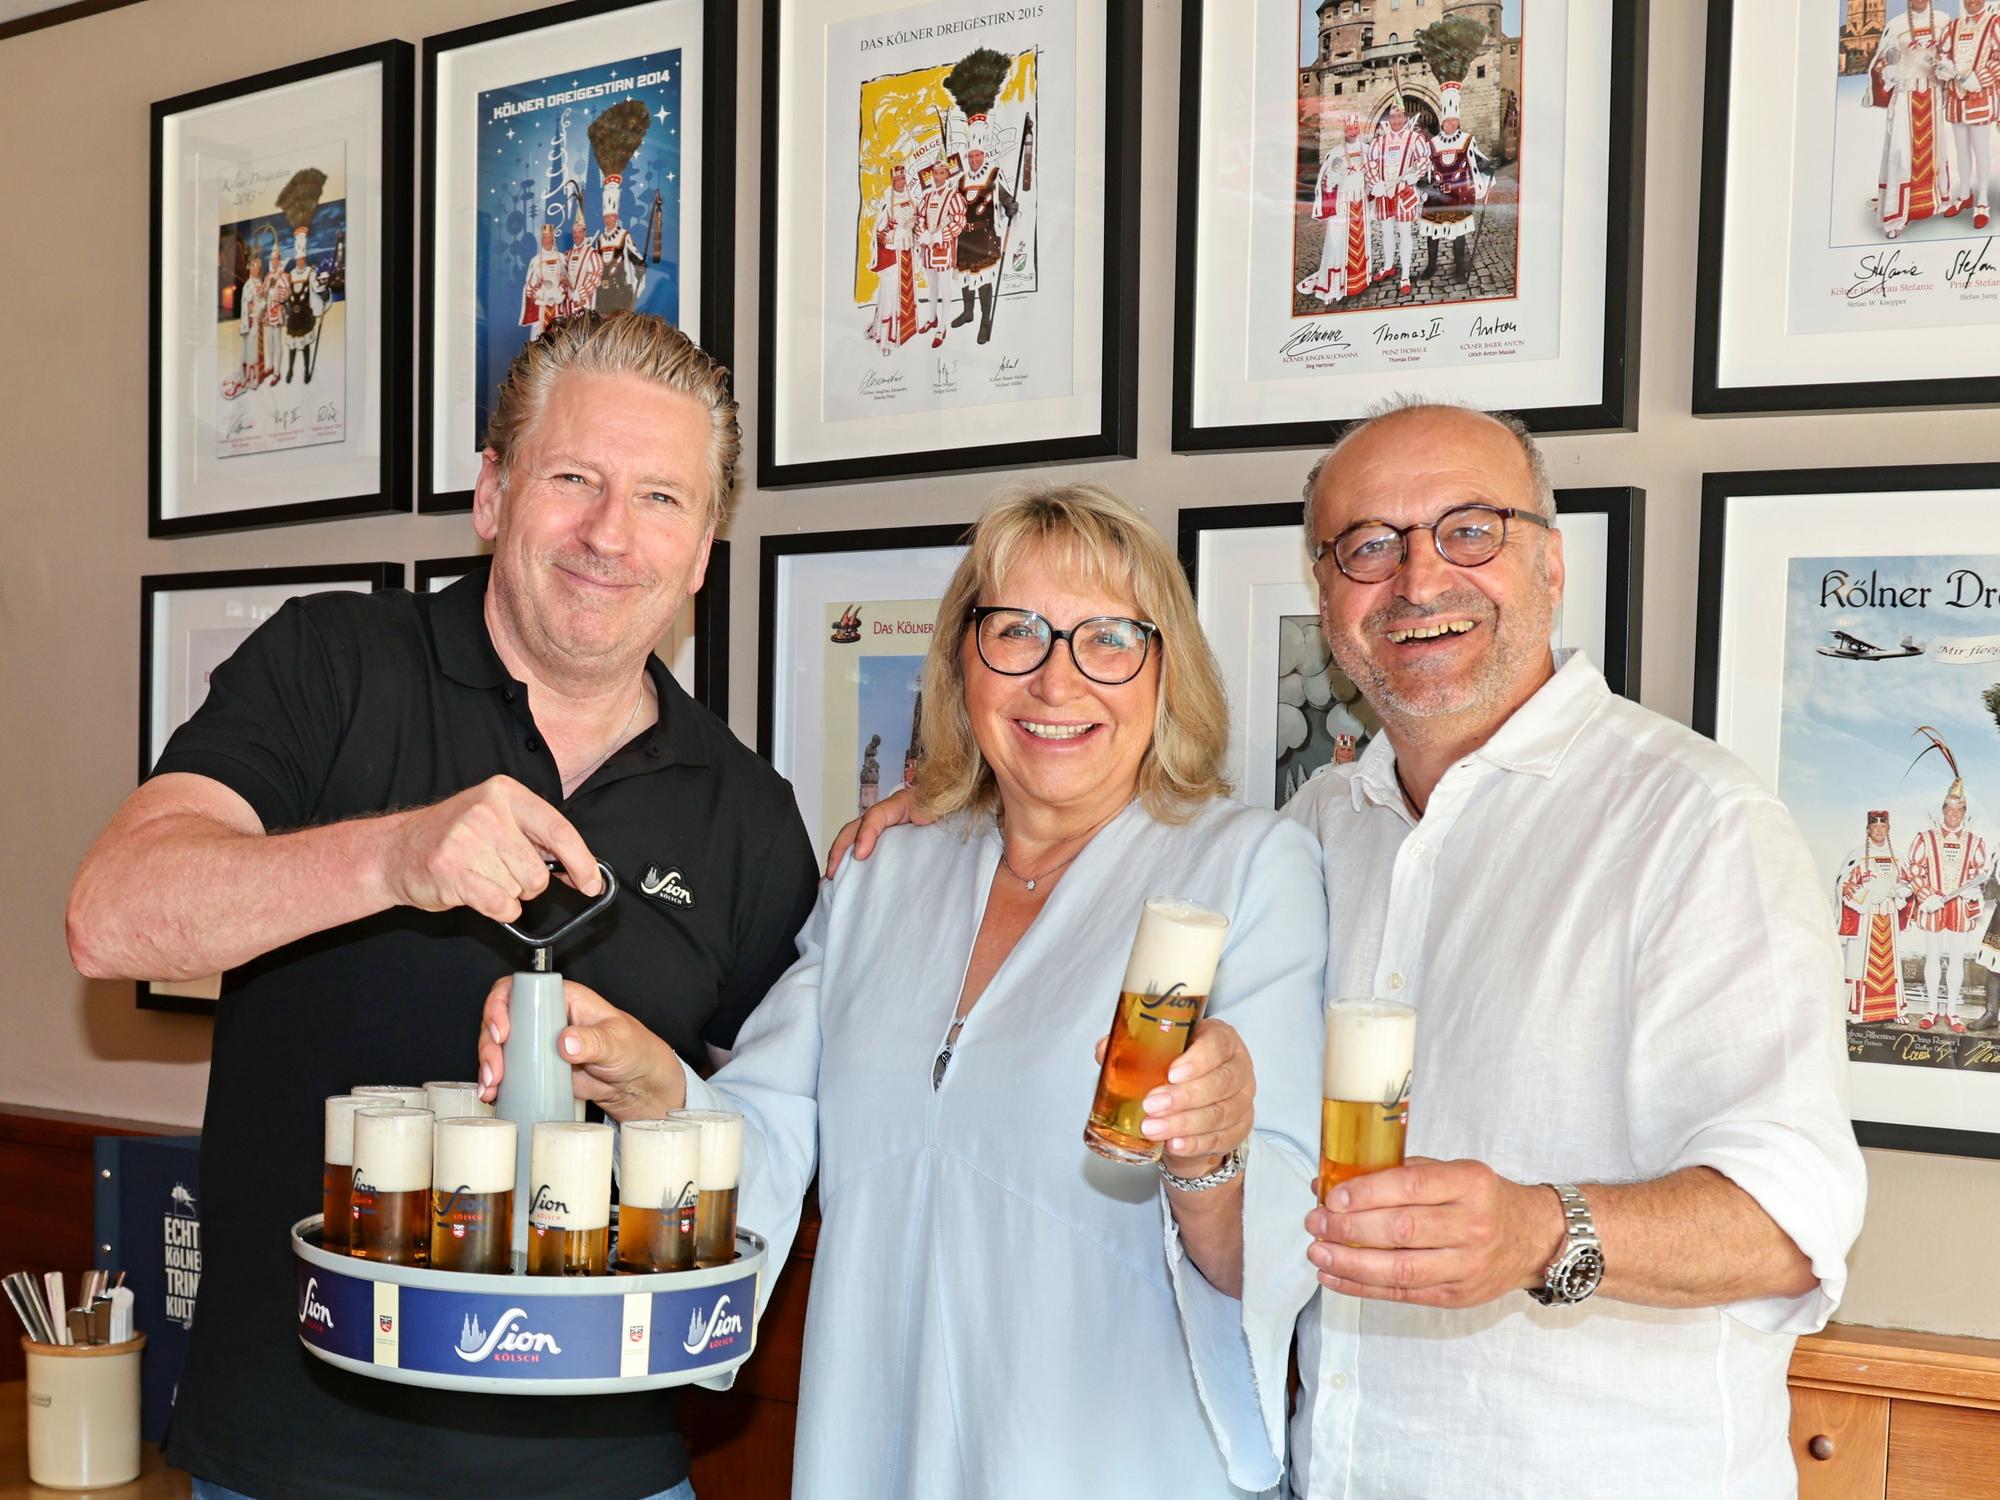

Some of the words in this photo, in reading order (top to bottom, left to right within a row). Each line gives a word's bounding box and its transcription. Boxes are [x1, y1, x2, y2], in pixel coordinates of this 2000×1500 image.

[860, 36, 883, 52] DAS
[886, 27, 934, 47] KÖLNER
[936, 11, 1015, 36] DREIGESTIRN
[1018, 5, 1044, 20] 2015
[493, 97, 544, 120] KÖLNER
[547, 76, 634, 107] DREIGESTIRN
[636, 69, 670, 88] 2014
[912, 138, 941, 160] HOLGE
[1900, 282, 1934, 292] Stefanie
[1372, 324, 1426, 345] Thomas
[1470, 316, 1518, 337] Anton
[1820, 569, 1932, 608] Kölner
[1945, 569, 2000, 608] Dr
[640, 872, 692, 904] Sion
[1140, 982, 1200, 1008] Sion
[530, 1184, 570, 1214] Sion
[164, 1216, 200, 1249] ECHT
[165, 1245, 202, 1272] KÖLNE
[165, 1268, 202, 1298] TRIN
[166, 1295, 196, 1320] KULT
[299, 1277, 334, 1328] Sion
[454, 1307, 562, 1363] Sion
[683, 1294, 742, 1355] Sion
[494, 1353, 540, 1363] KÖLSCH
[708, 1337, 736, 1350] KÖLSCH
